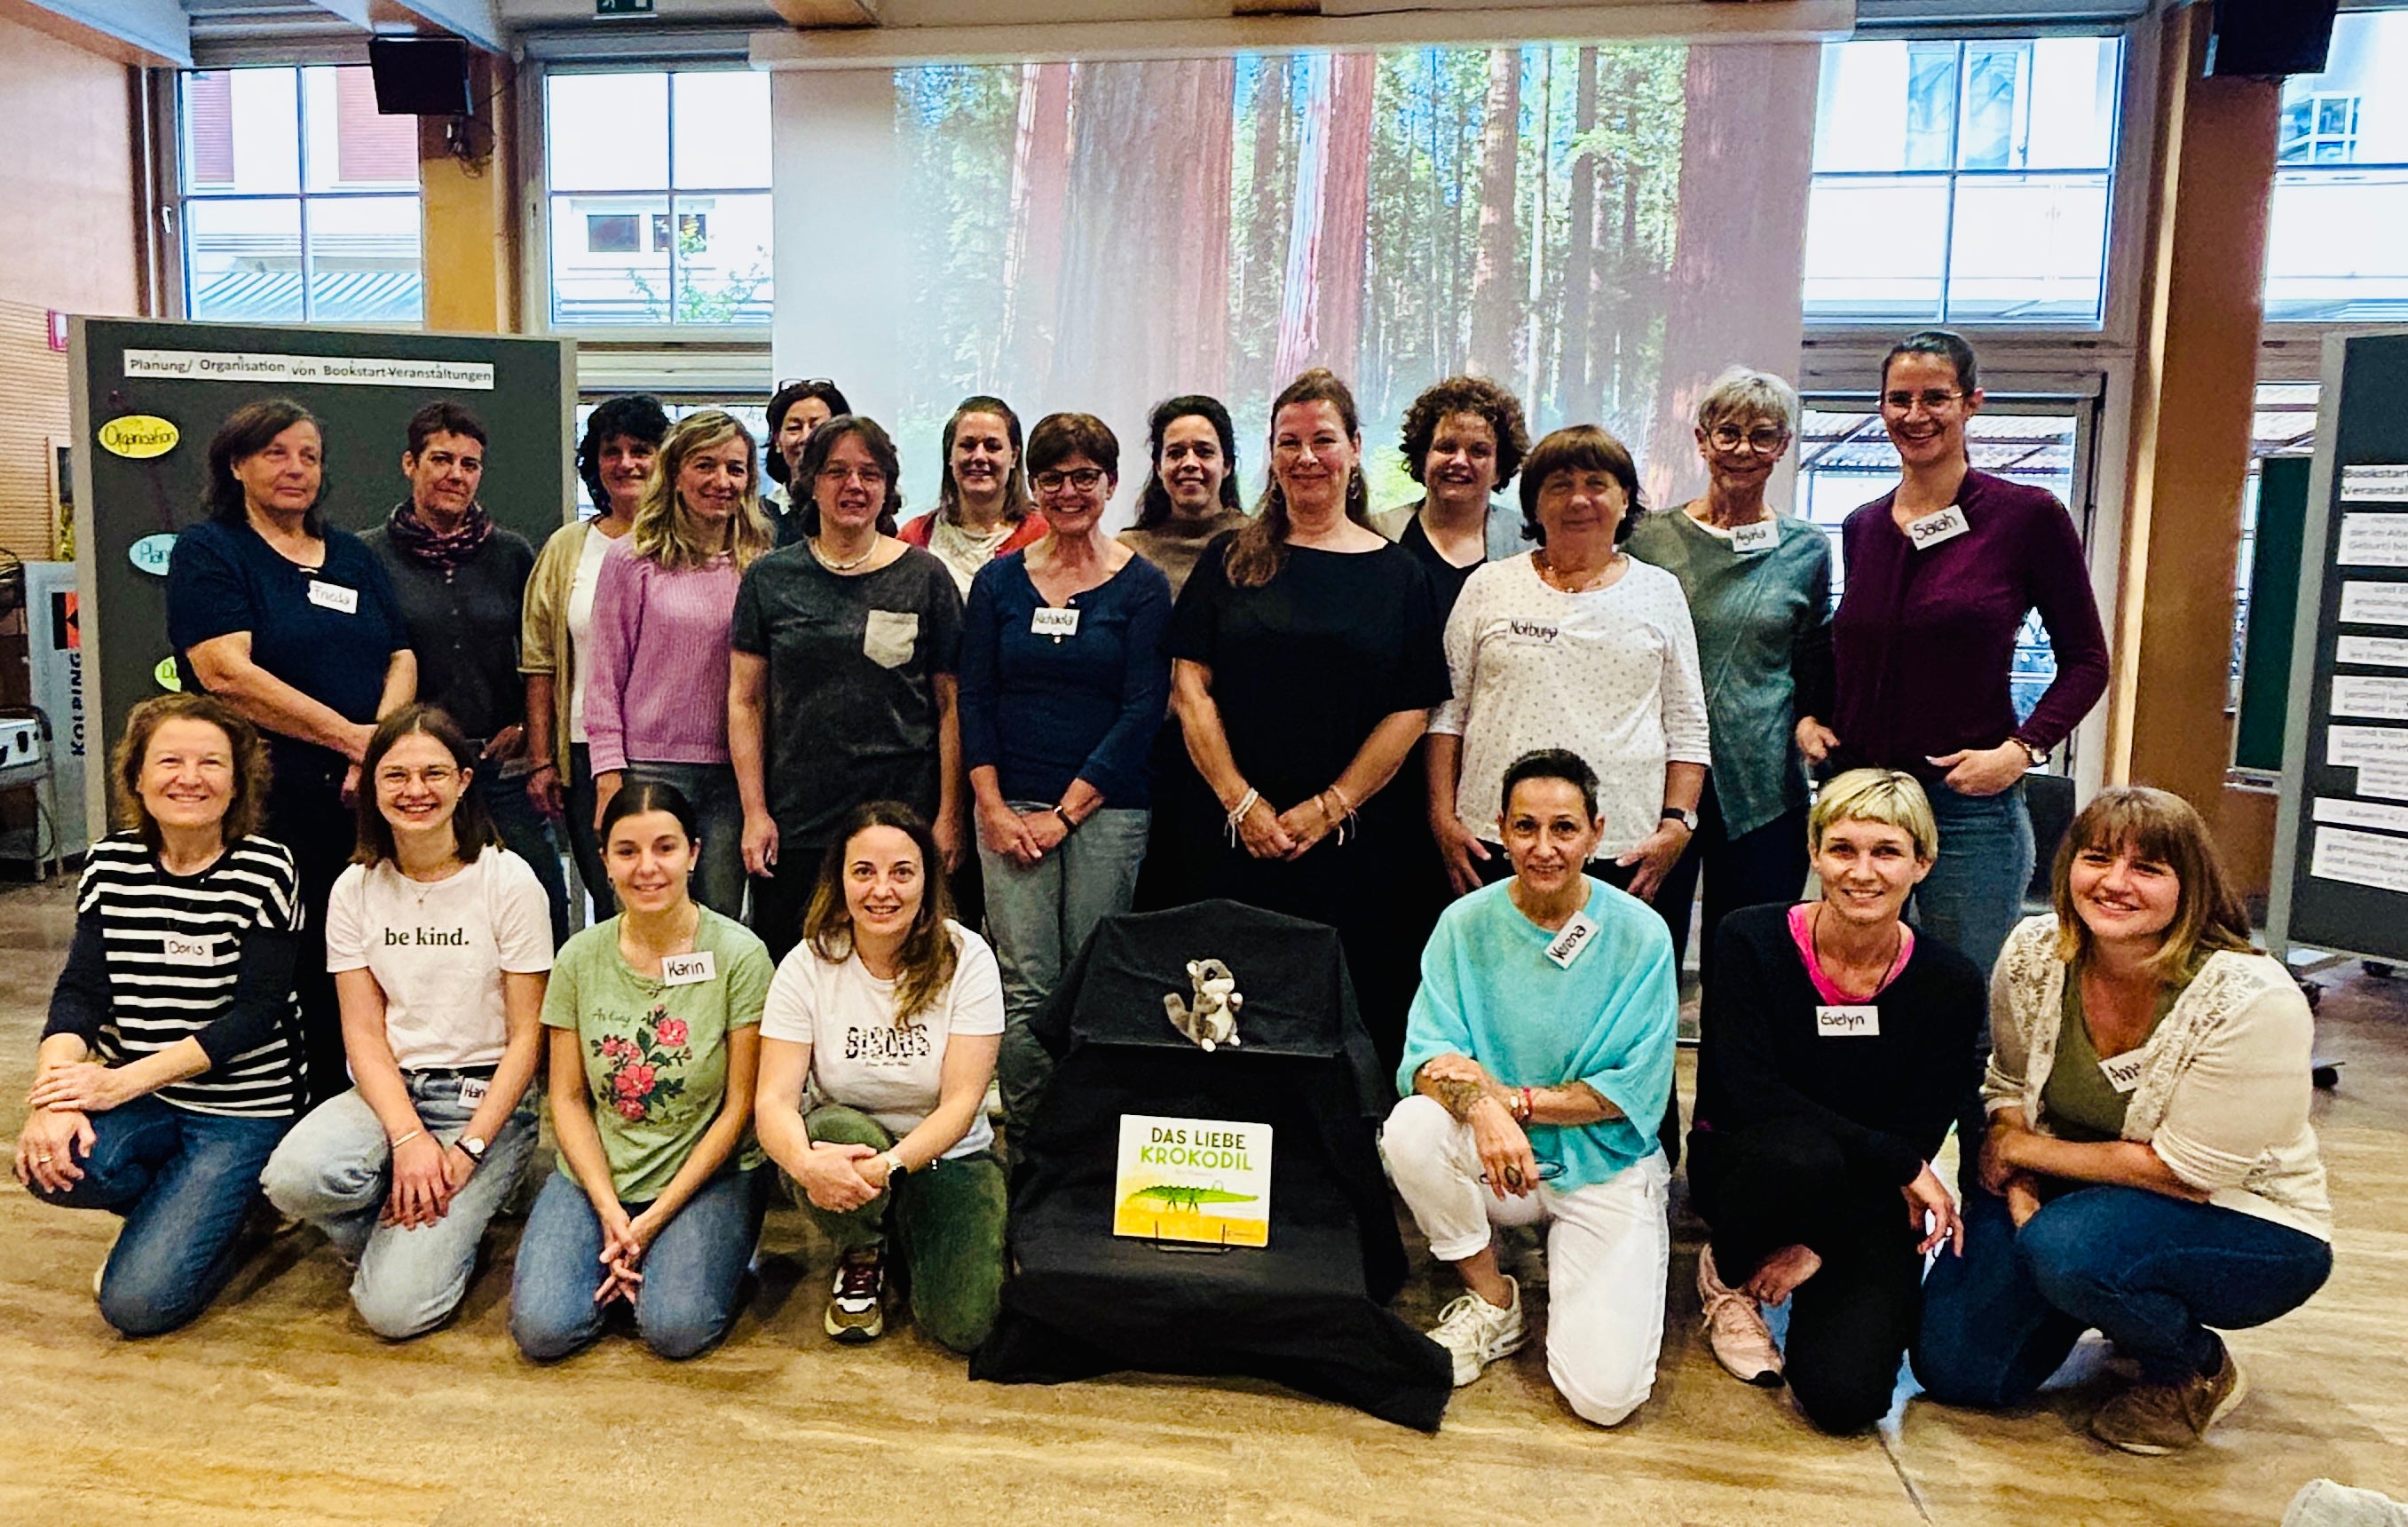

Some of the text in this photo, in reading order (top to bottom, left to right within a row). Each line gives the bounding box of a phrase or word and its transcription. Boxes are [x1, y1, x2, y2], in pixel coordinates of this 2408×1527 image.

[200, 358, 286, 374] Organisation
[291, 366, 316, 376] von
[104, 424, 177, 453] Organisation
[1914, 513, 1958, 540] Sarah
[1510, 621, 1558, 643] Notburga
[384, 927, 470, 945] be kind.
[1549, 924, 1587, 960] Verena
[169, 940, 204, 955] Doris
[667, 961, 706, 977] Karin
[1820, 1012, 1865, 1031] Evelyn
[1151, 1127, 1246, 1150] DAS LIEBE
[1141, 1145, 1253, 1171] KROKODIL
